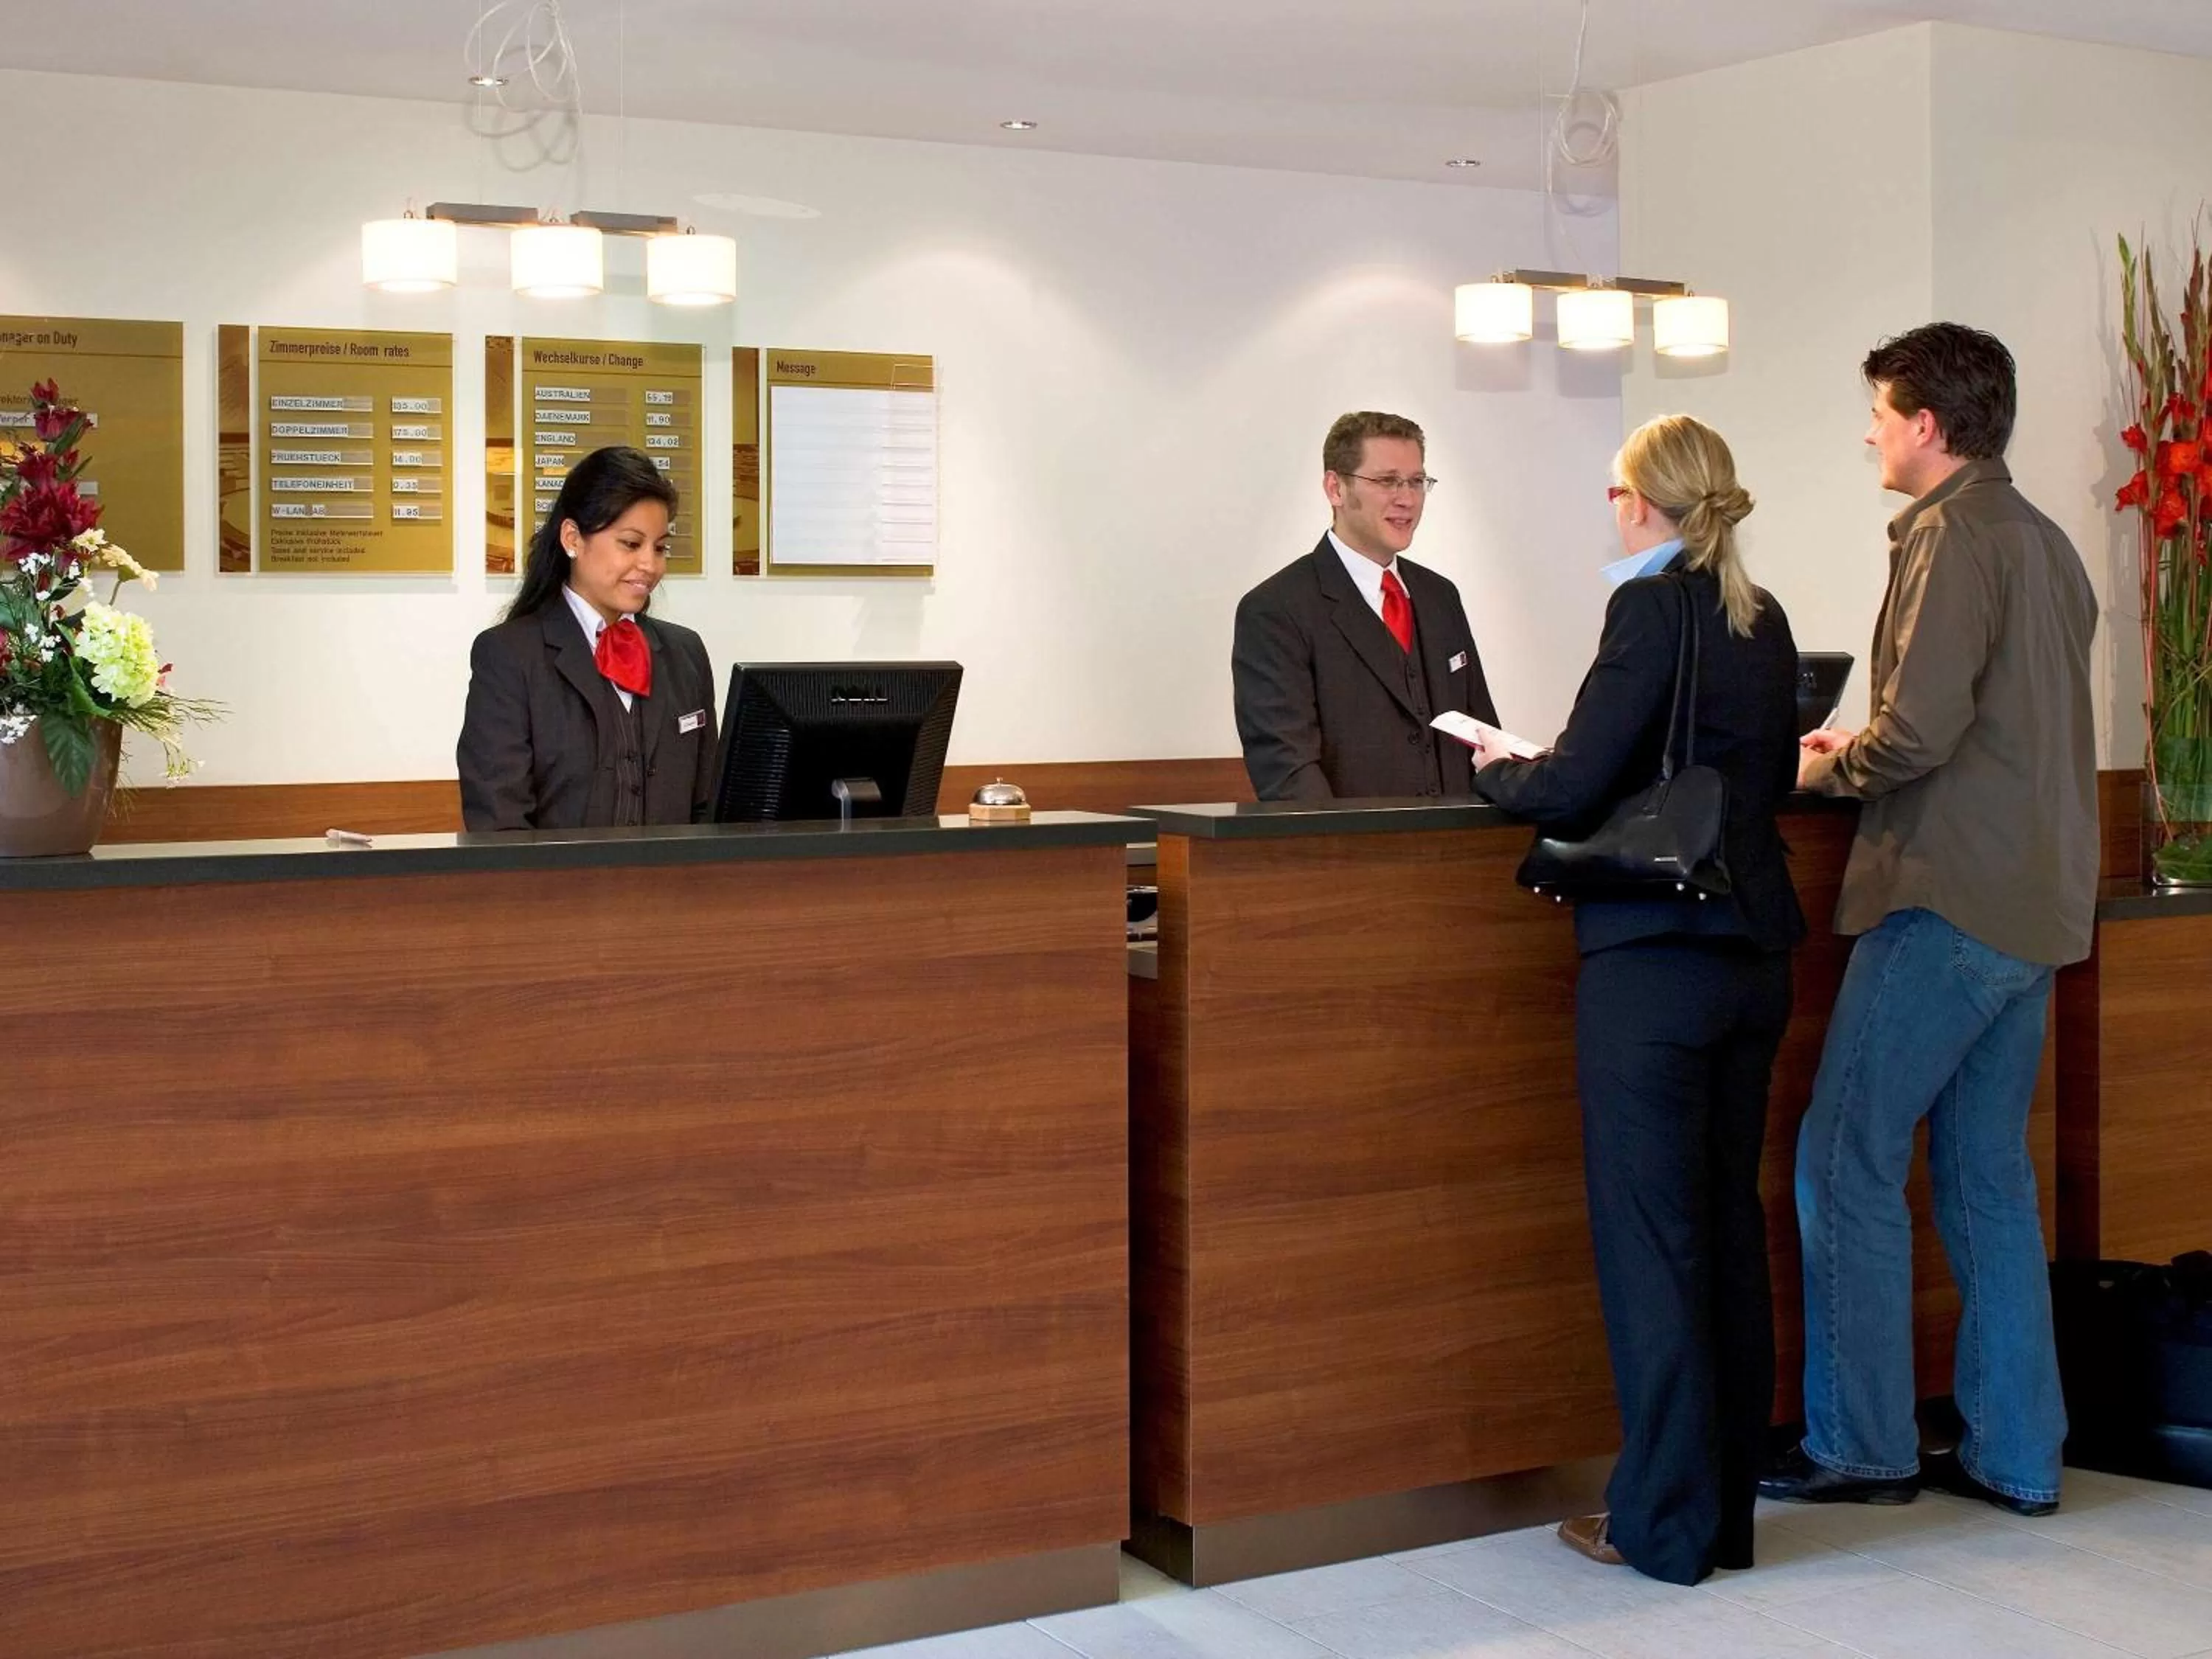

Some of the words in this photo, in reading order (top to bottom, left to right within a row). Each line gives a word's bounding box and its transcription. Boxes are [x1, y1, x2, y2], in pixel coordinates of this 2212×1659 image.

[0, 332, 32, 346] nager
[38, 333, 50, 344] on
[54, 331, 77, 347] Duty
[269, 339, 341, 358] Zimmerpreise
[350, 342, 378, 357] Room
[384, 344, 409, 358] rates
[533, 349, 601, 365] Wechselkurse
[608, 353, 644, 369] Change
[776, 359, 815, 377] Message
[535, 389, 591, 399] AUSTRALIEN
[272, 397, 343, 408] EINZELZIMMER
[535, 411, 590, 421] DAENEMARK
[272, 425, 347, 435] DOPPELZIMMER
[535, 434, 576, 443] ENGLAND
[271, 453, 340, 462] FRUEHSTUECK
[536, 456, 564, 465] JAPAN
[272, 479, 354, 489] TELEFONEINHEIT
